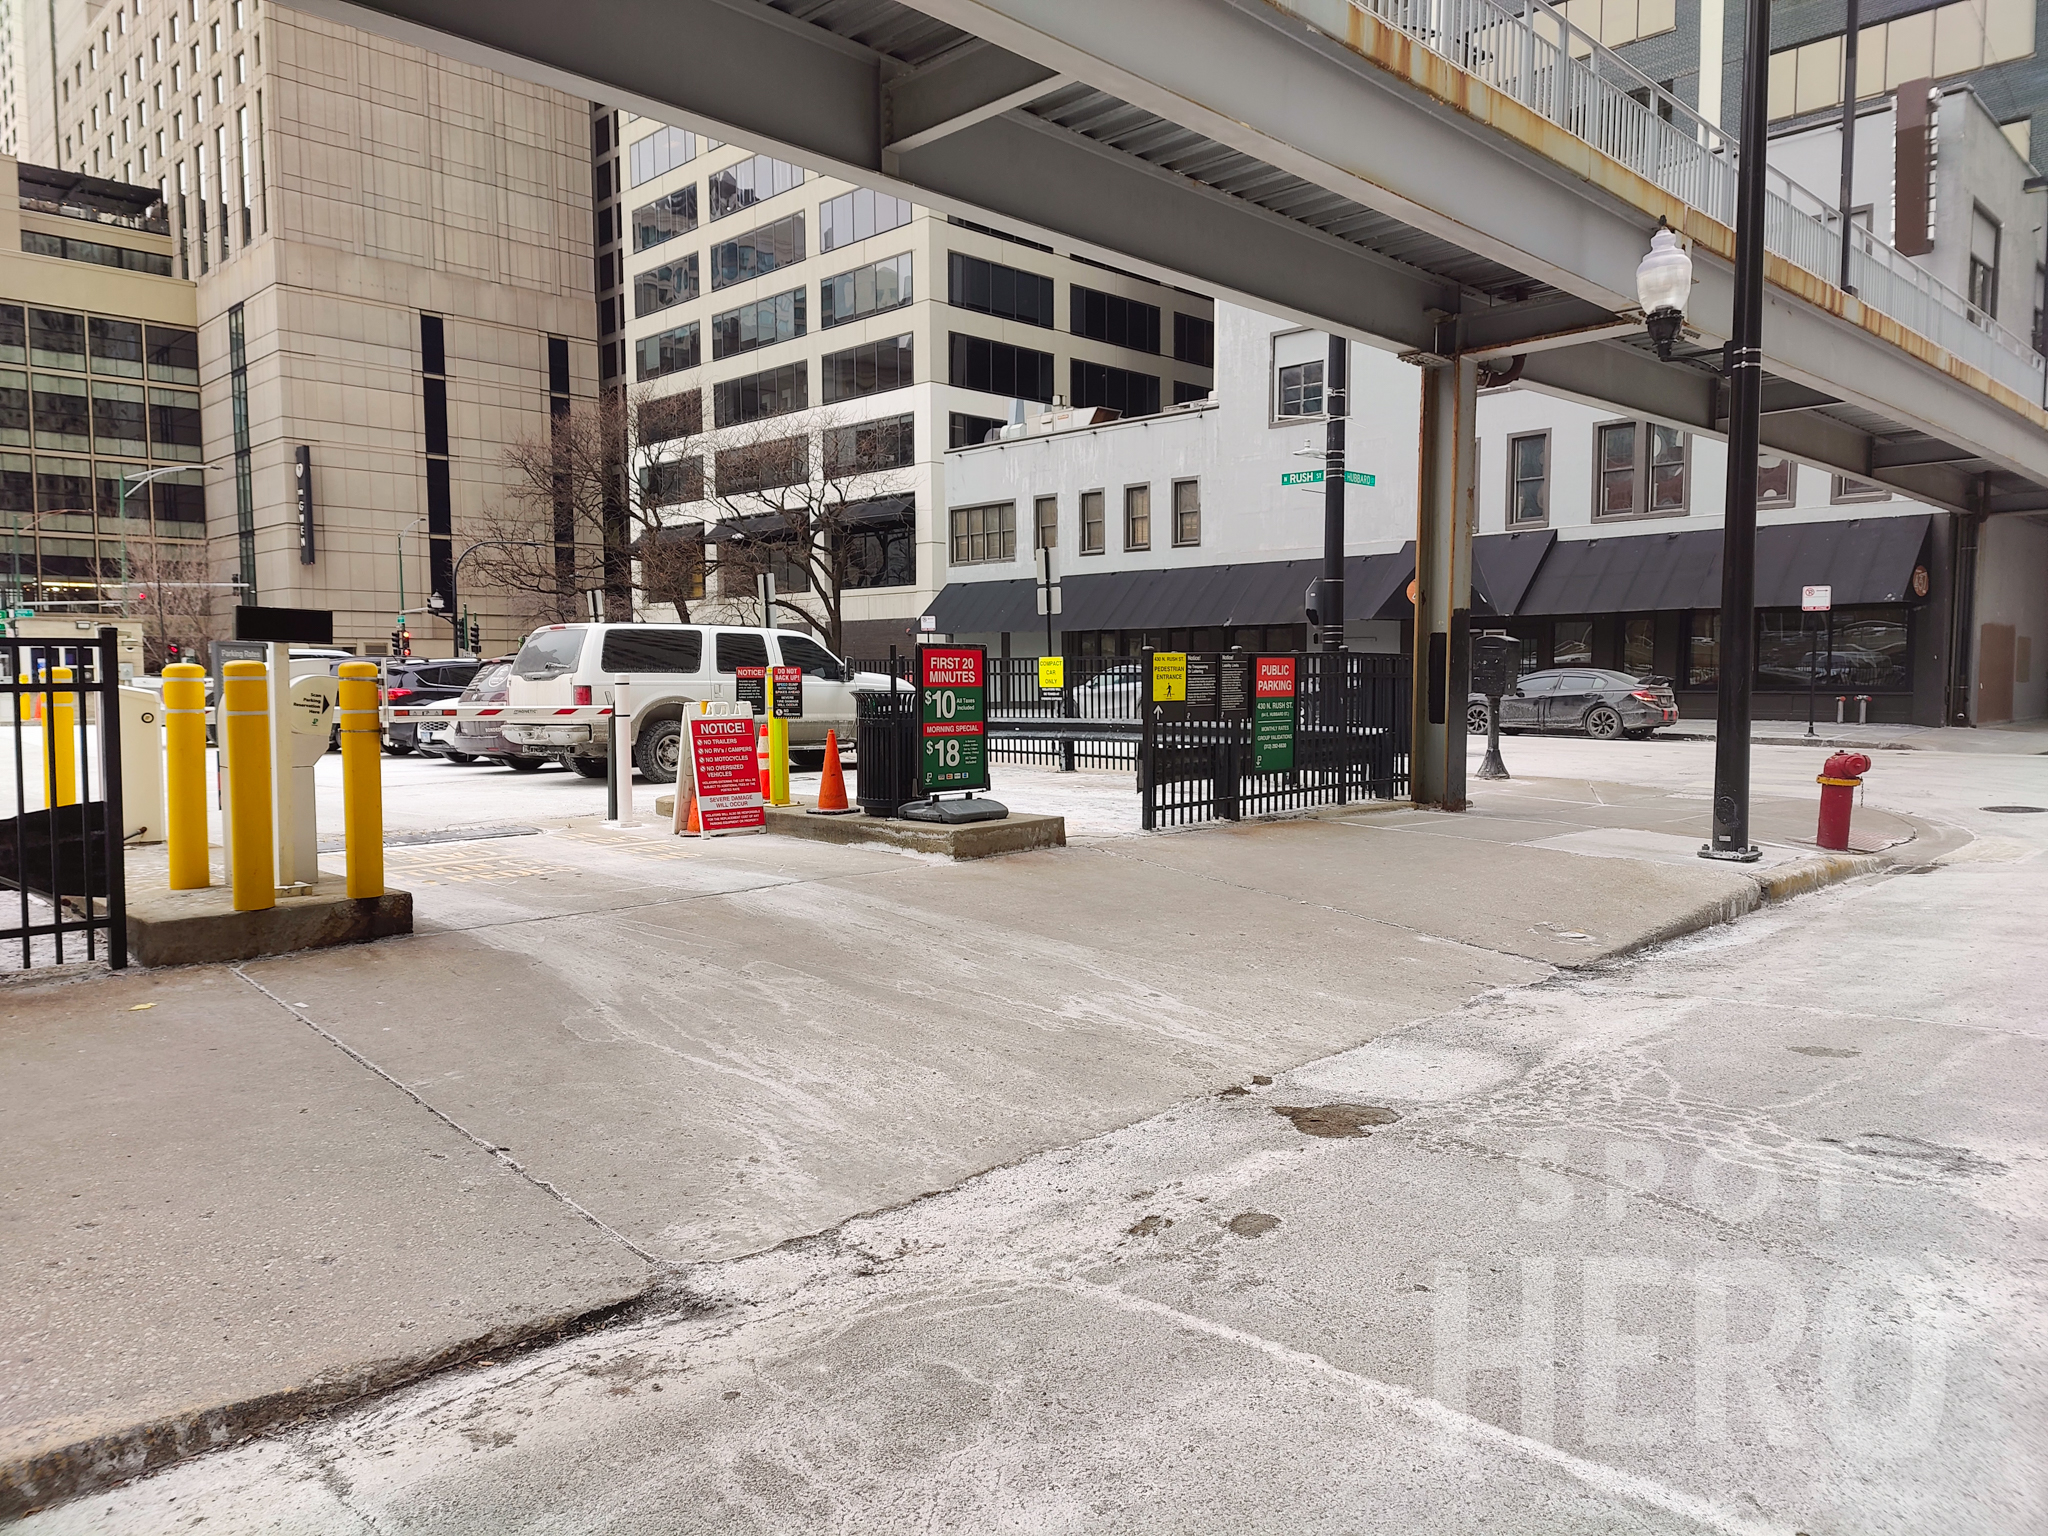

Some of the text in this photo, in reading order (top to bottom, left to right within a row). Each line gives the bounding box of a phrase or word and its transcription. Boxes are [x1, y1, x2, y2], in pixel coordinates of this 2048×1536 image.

[1290, 472, 1314, 484] RUSH
[1347, 472, 1370, 484] HUBBARD
[221, 650, 244, 659] Parking
[930, 657, 974, 669] FIRST 20
[1261, 665, 1290, 676] PUBLIC
[929, 671, 976, 683] MINUTES
[1258, 680, 1292, 691] PARKING
[924, 690, 956, 719] $10
[700, 722, 746, 734] NOTICE!
[926, 724, 979, 734] MORNING SPECIAL
[926, 739, 960, 767] $18
